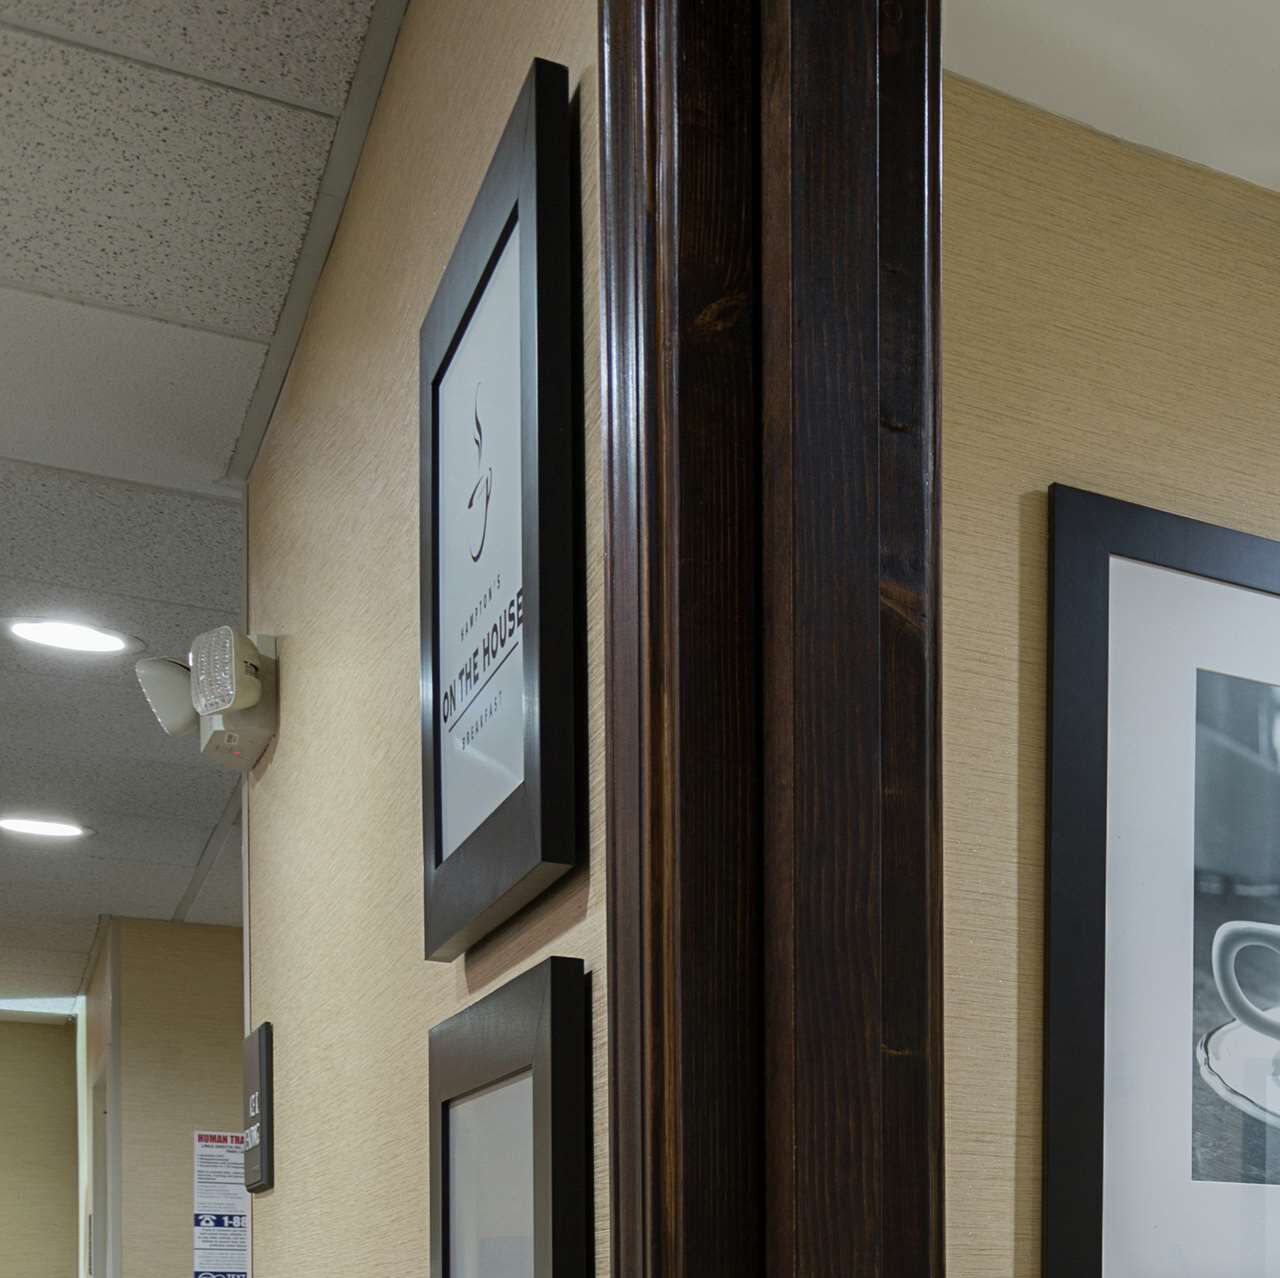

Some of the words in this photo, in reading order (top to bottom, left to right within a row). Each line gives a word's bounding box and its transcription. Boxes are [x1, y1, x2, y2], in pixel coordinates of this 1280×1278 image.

[460, 574, 502, 641] HAMPTON'S
[442, 680, 457, 724] ON
[458, 648, 480, 703] THE
[482, 587, 524, 673] HOUSE
[462, 689, 503, 751] BREAKFAST
[197, 1134, 228, 1144] HUMAN
